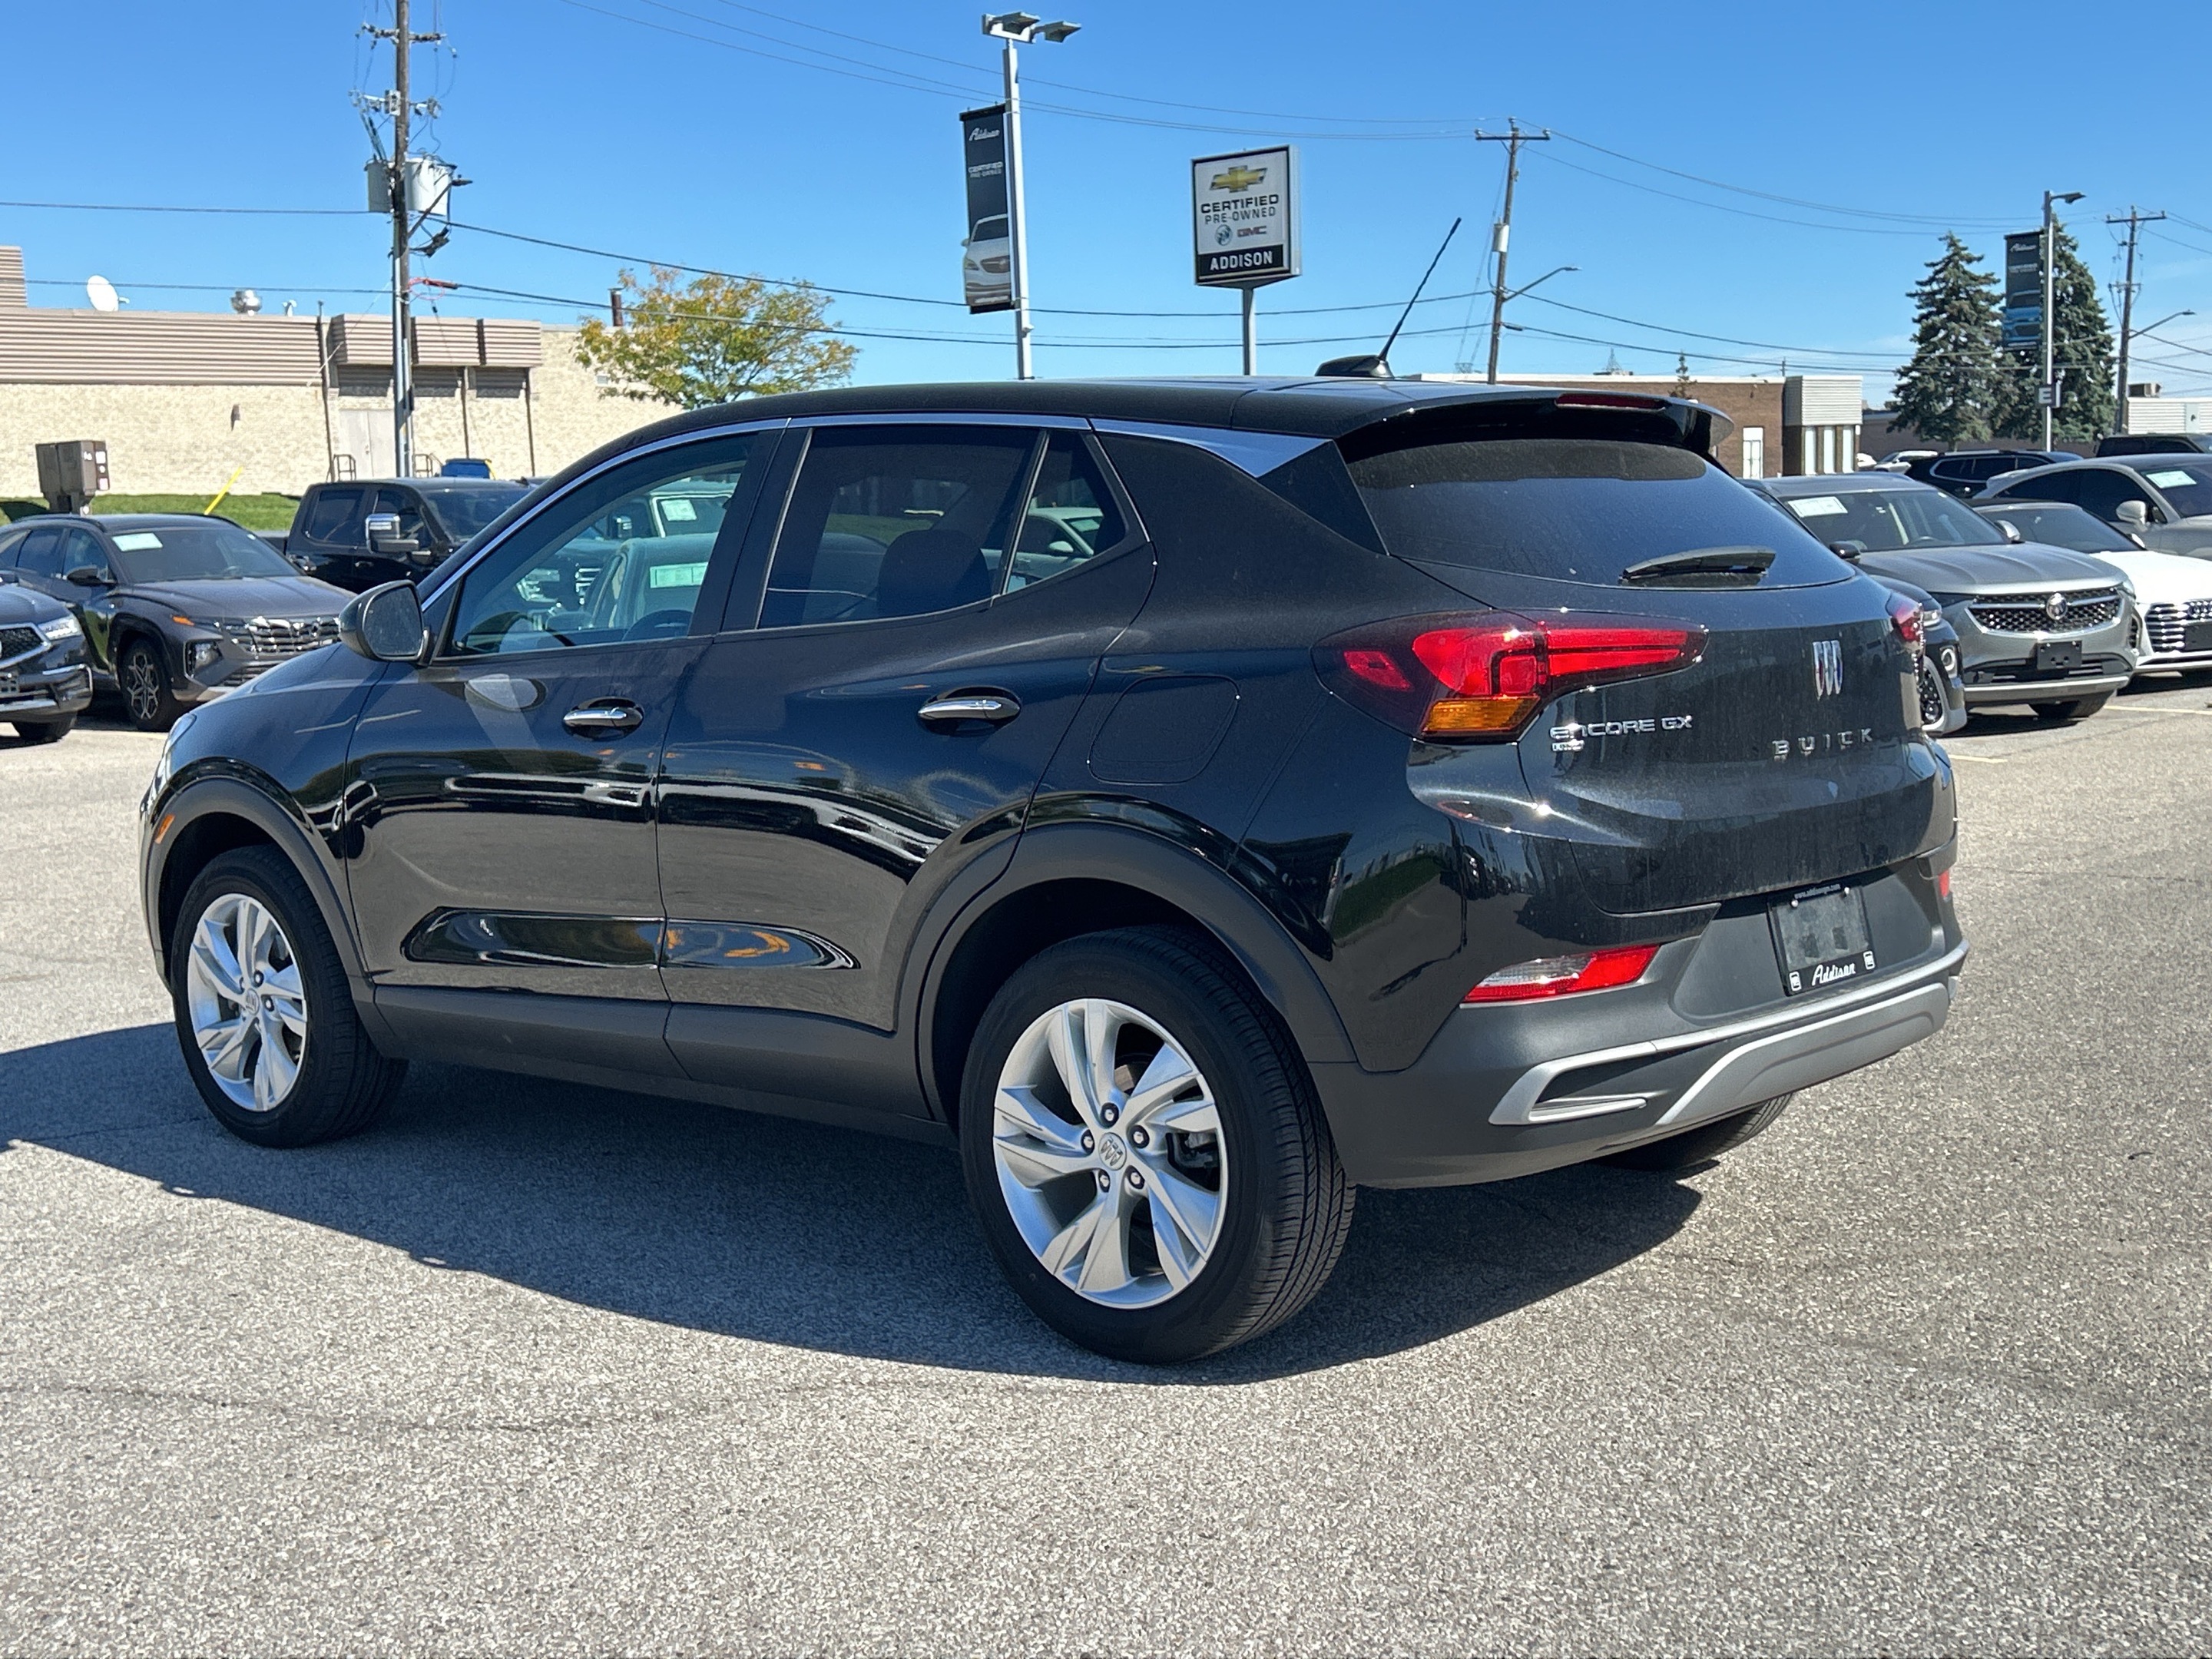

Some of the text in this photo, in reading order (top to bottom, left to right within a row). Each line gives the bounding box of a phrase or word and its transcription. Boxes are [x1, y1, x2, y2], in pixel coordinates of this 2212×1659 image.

[1200, 194, 1279, 214] CERTIFIED
[1204, 207, 1276, 224] PRE-OWNED
[1237, 226, 1267, 237] GMC
[1210, 250, 1273, 270] ADDISON
[2038, 387, 2051, 403] E
[1550, 715, 1692, 740] ENCORE GX
[1772, 728, 1873, 756] BUICK
[1812, 963, 1856, 986] Addison
